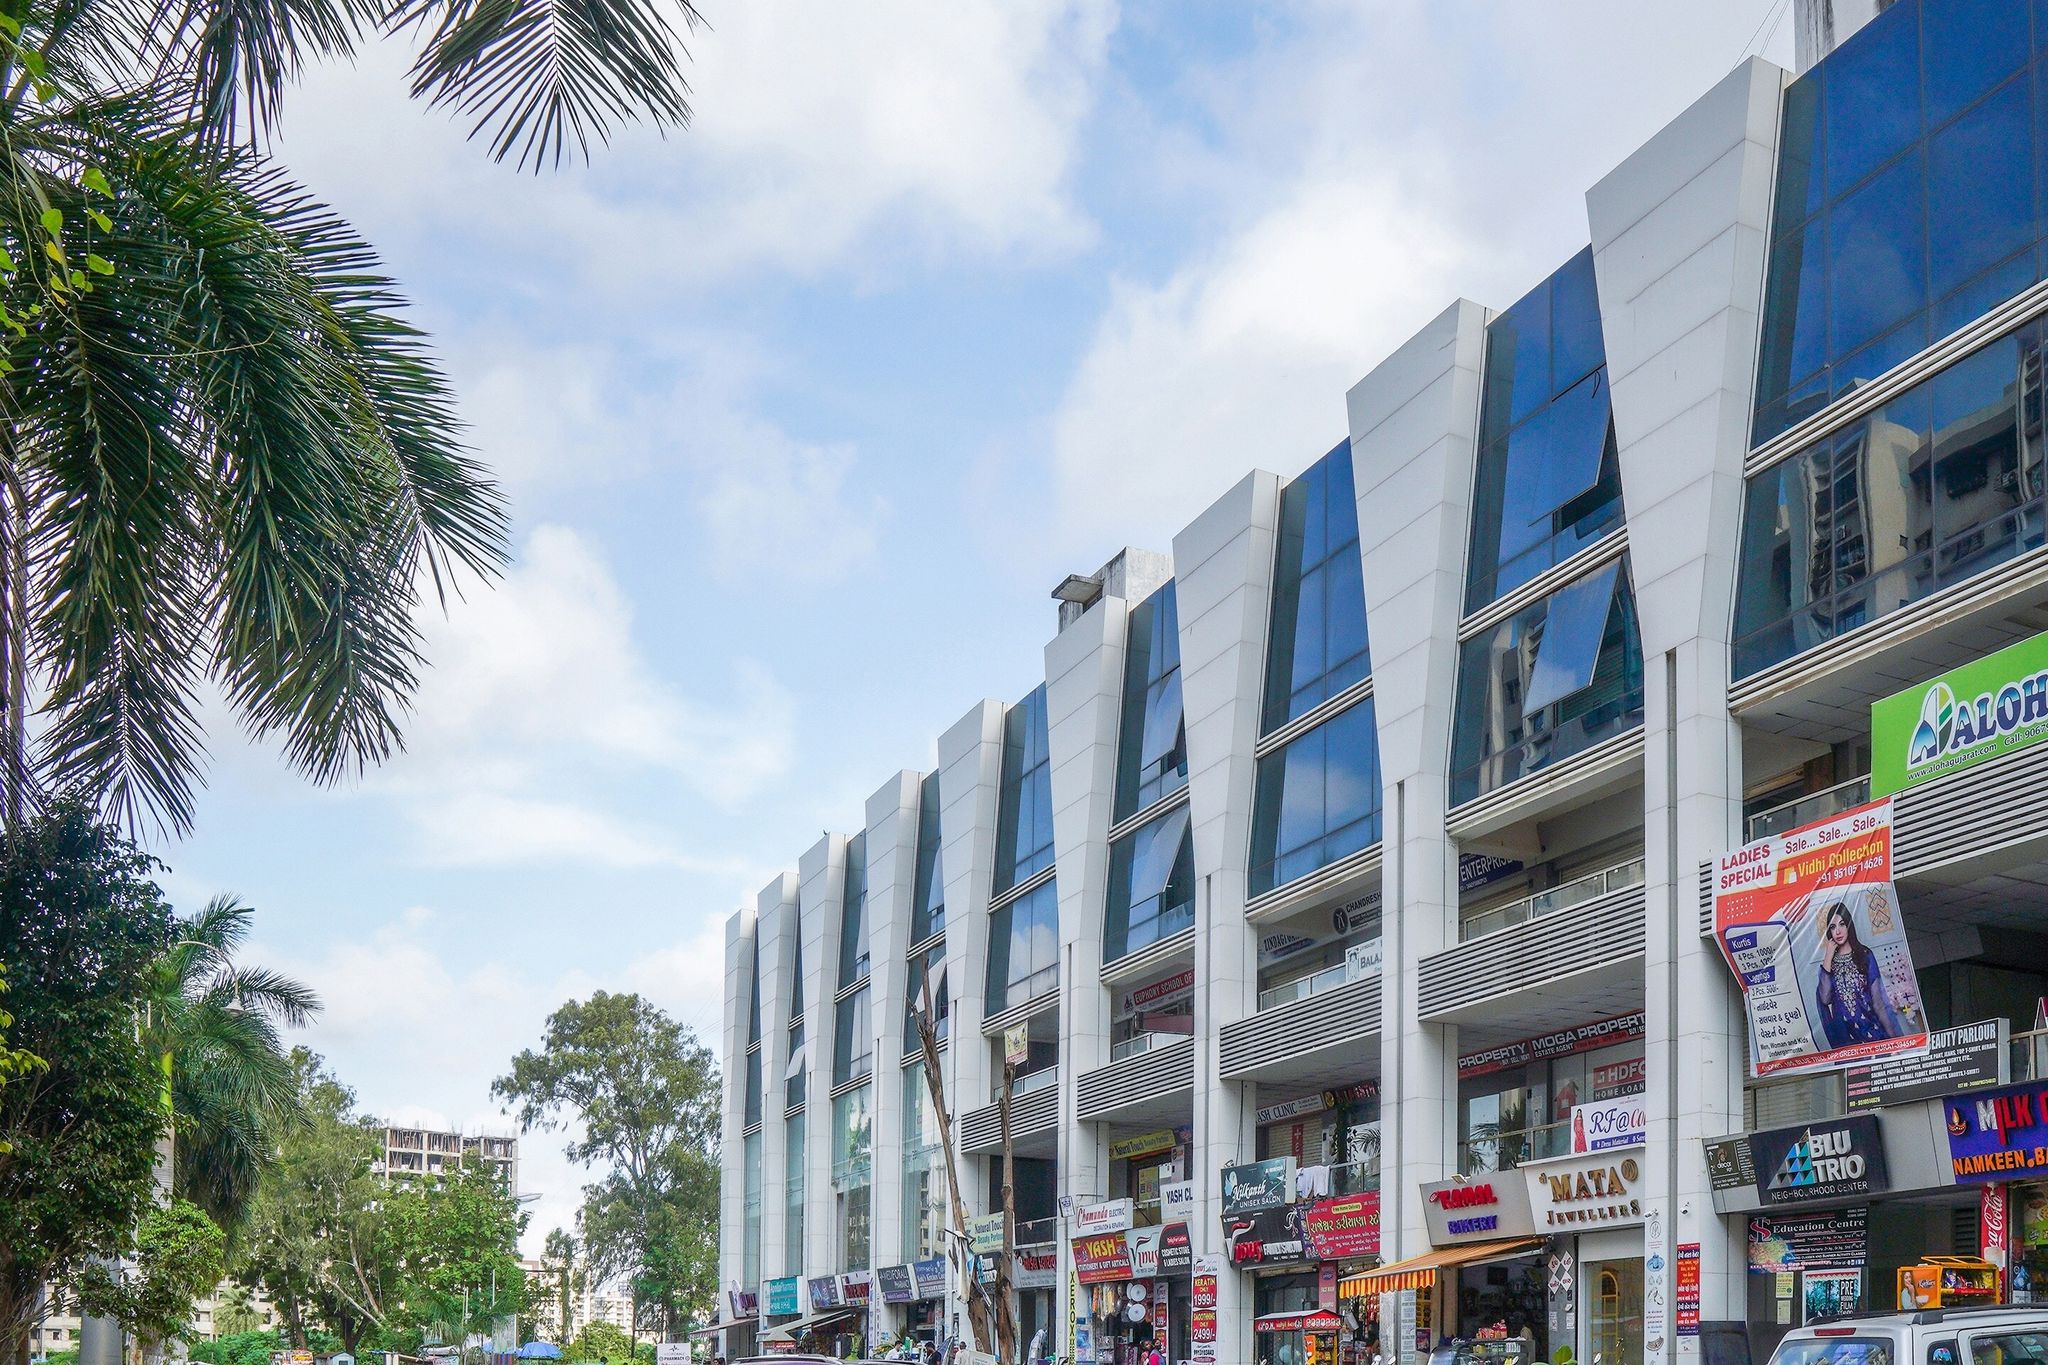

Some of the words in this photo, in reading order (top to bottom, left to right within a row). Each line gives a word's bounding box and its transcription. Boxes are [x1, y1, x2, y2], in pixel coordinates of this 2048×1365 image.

[1950, 673, 2048, 750] ALOH
[1907, 743, 1997, 780] www.alohagujarat.com
[2004, 732, 2023, 746] Call:
[1785, 840, 1816, 855] Sale...
[1818, 828, 1850, 844] Sale...
[1721, 844, 1771, 871] LADIES
[1798, 855, 1826, 877] Vidhi
[1829, 840, 1884, 868] Collection
[1720, 863, 1772, 889] SPECIAL
[1815, 872, 1831, 885] +91
[1833, 864, 1857, 880] 95105
[1860, 855, 1883, 872] 14626
[1264, 933, 1287, 952] ZINDAGI
[1731, 937, 1752, 950] Kurtis
[1743, 950, 1756, 961] Pcs.
[1747, 960, 1761, 970] Pcs.
[1134, 985, 1160, 1003] EUPHONY
[1161, 976, 1184, 993] SCHOOL
[1184, 972, 1193, 985] OF
[1459, 1043, 1526, 1068] PROPERTY
[1531, 1031, 1577, 1051] MOGA
[1577, 1013, 1645, 1040] PROPERT
[1787, 1039, 1797, 1047] and
[1930, 1029, 1956, 1050] EAUTY
[1958, 1023, 1996, 1045] PARLOUR
[1534, 1048, 1555, 1058] ESTATE
[1555, 1043, 1574, 1055] AGENT
[1839, 1049, 1858, 1059] GREEN
[1595, 1087, 1619, 1100] HOME
[1621, 1083, 1645, 1094] LOAN
[1256, 1109, 1272, 1123] ASH
[1273, 1103, 1298, 1120] CLINIC
[1975, 1093, 2034, 1145] MILK
[1810, 1129, 1852, 1158] BLU
[1812, 1154, 1866, 1183] TRIO
[1549, 1166, 1627, 1202] MATA
[1837, 1180, 1868, 1193] CENTER
[1166, 1188, 1183, 1204] YASH
[1239, 1199, 1260, 1208] UNISEX
[1261, 1195, 1281, 1205] SALON
[1077, 1206, 1108, 1229] Chamunda
[1108, 1207, 1125, 1218] ELECTRIC
[1546, 1199, 1641, 1225] JEWELLERS
[974, 1221, 991, 1234] Natural
[1772, 1222, 1825, 1234] Education
[1828, 1219, 1865, 1229] Centre
[1085, 1238, 1116, 1259] YASH
[1194, 1278, 1216, 1287] KERATIN
[1840, 1281, 1854, 1295] PRE
[1194, 1293, 1216, 1305] 1999/-
[1840, 1302, 1854, 1310] FILM
[1194, 1328, 1216, 1340] 2499/-
